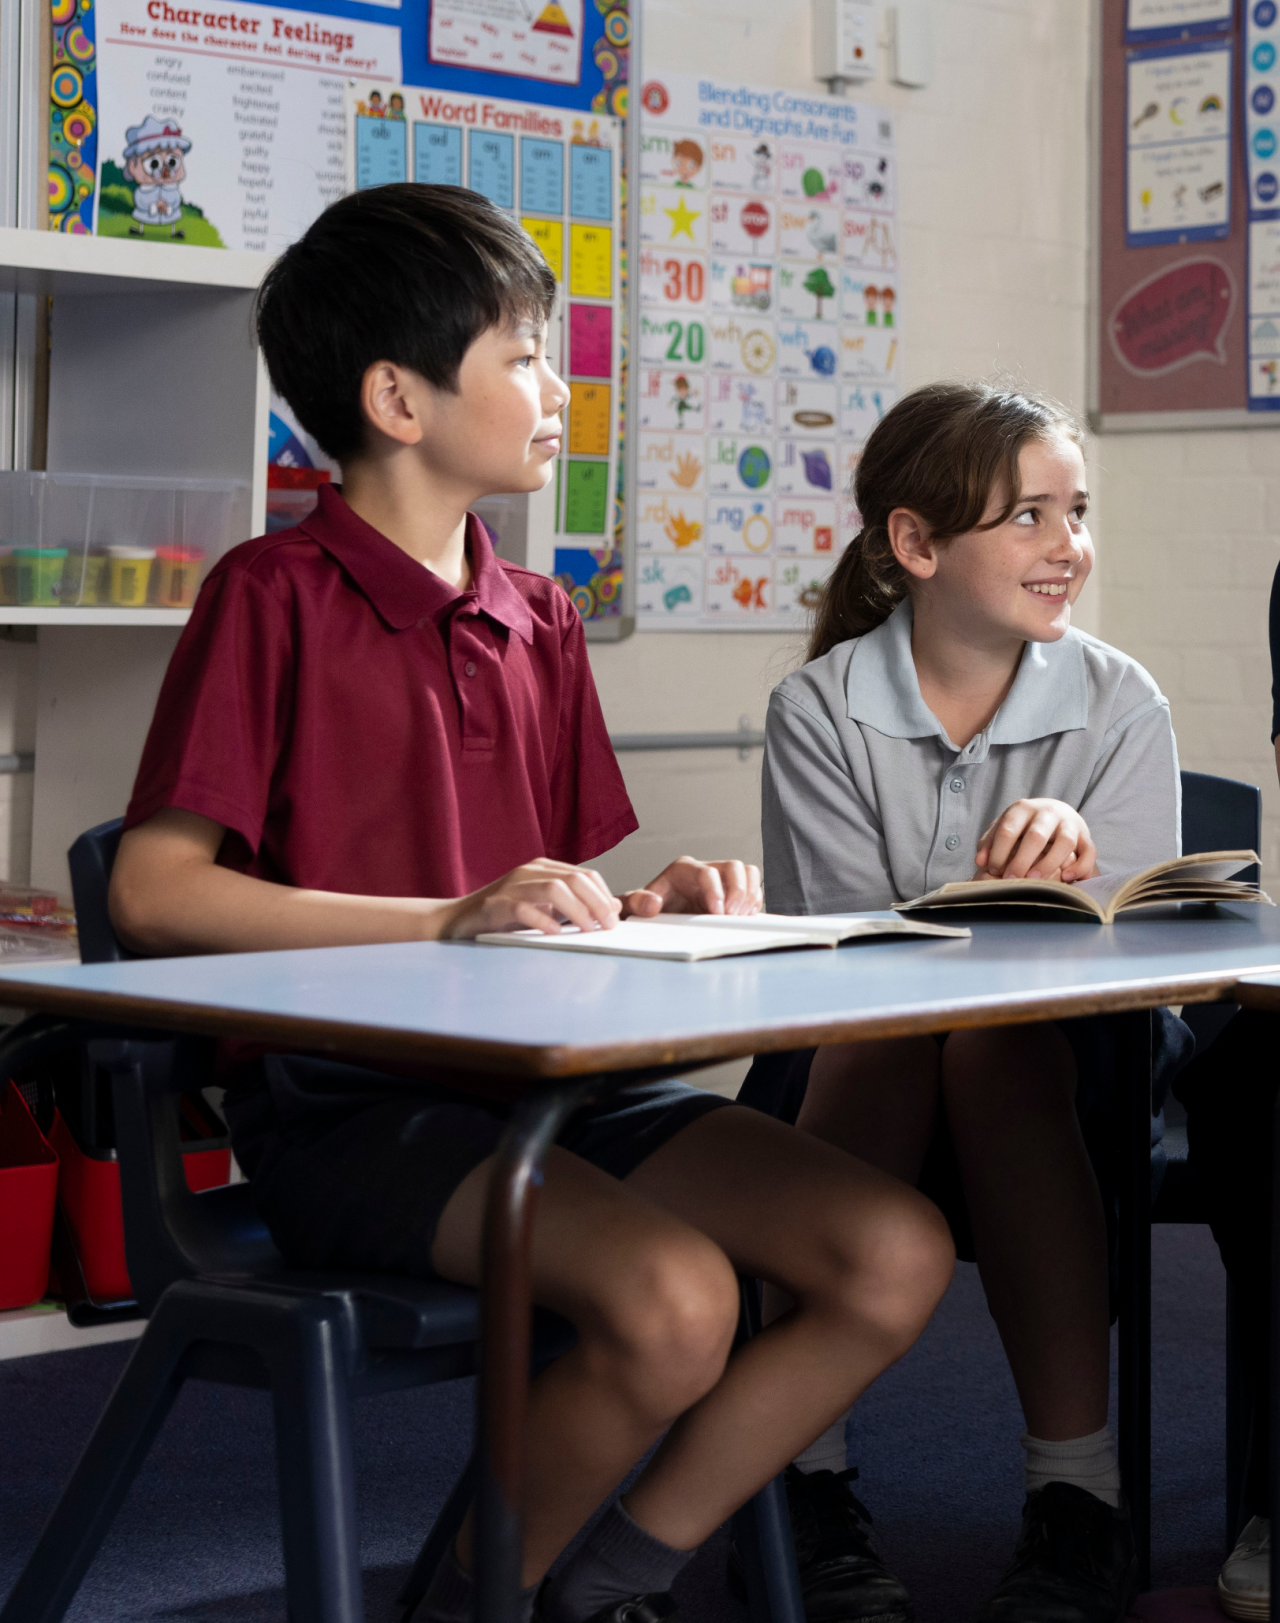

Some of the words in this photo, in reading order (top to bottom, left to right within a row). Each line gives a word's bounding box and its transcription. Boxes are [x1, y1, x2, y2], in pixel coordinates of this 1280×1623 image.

[147, 1, 261, 34] Character
[272, 18, 354, 52] Feelings
[120, 22, 146, 36] How
[152, 27, 176, 42] does
[182, 30, 199, 43] the
[204, 34, 257, 51] character
[263, 42, 283, 55] feel
[287, 45, 321, 63] during
[326, 50, 340, 63] the
[344, 54, 378, 70] story?
[155, 55, 182, 69] angry
[146, 70, 191, 84] confused
[150, 87, 187, 99] content
[699, 81, 770, 114] Blending
[773, 91, 857, 122] Consonants
[419, 95, 477, 124] Word
[482, 104, 563, 137] Families
[371, 122, 391, 140] ab
[699, 109, 731, 128] and
[733, 111, 801, 137] Digraphs
[805, 120, 829, 140] Are
[831, 124, 856, 144] Fun
[429, 128, 448, 146] ad
[640, 135, 671, 152] sm
[483, 141, 500, 161] ag
[711, 144, 736, 161] sn
[782, 153, 804, 170] sn
[711, 203, 728, 223] st
[664, 258, 706, 303] 30
[666, 319, 706, 363] 20
[711, 319, 743, 343] wh
[779, 322, 810, 347] wh
